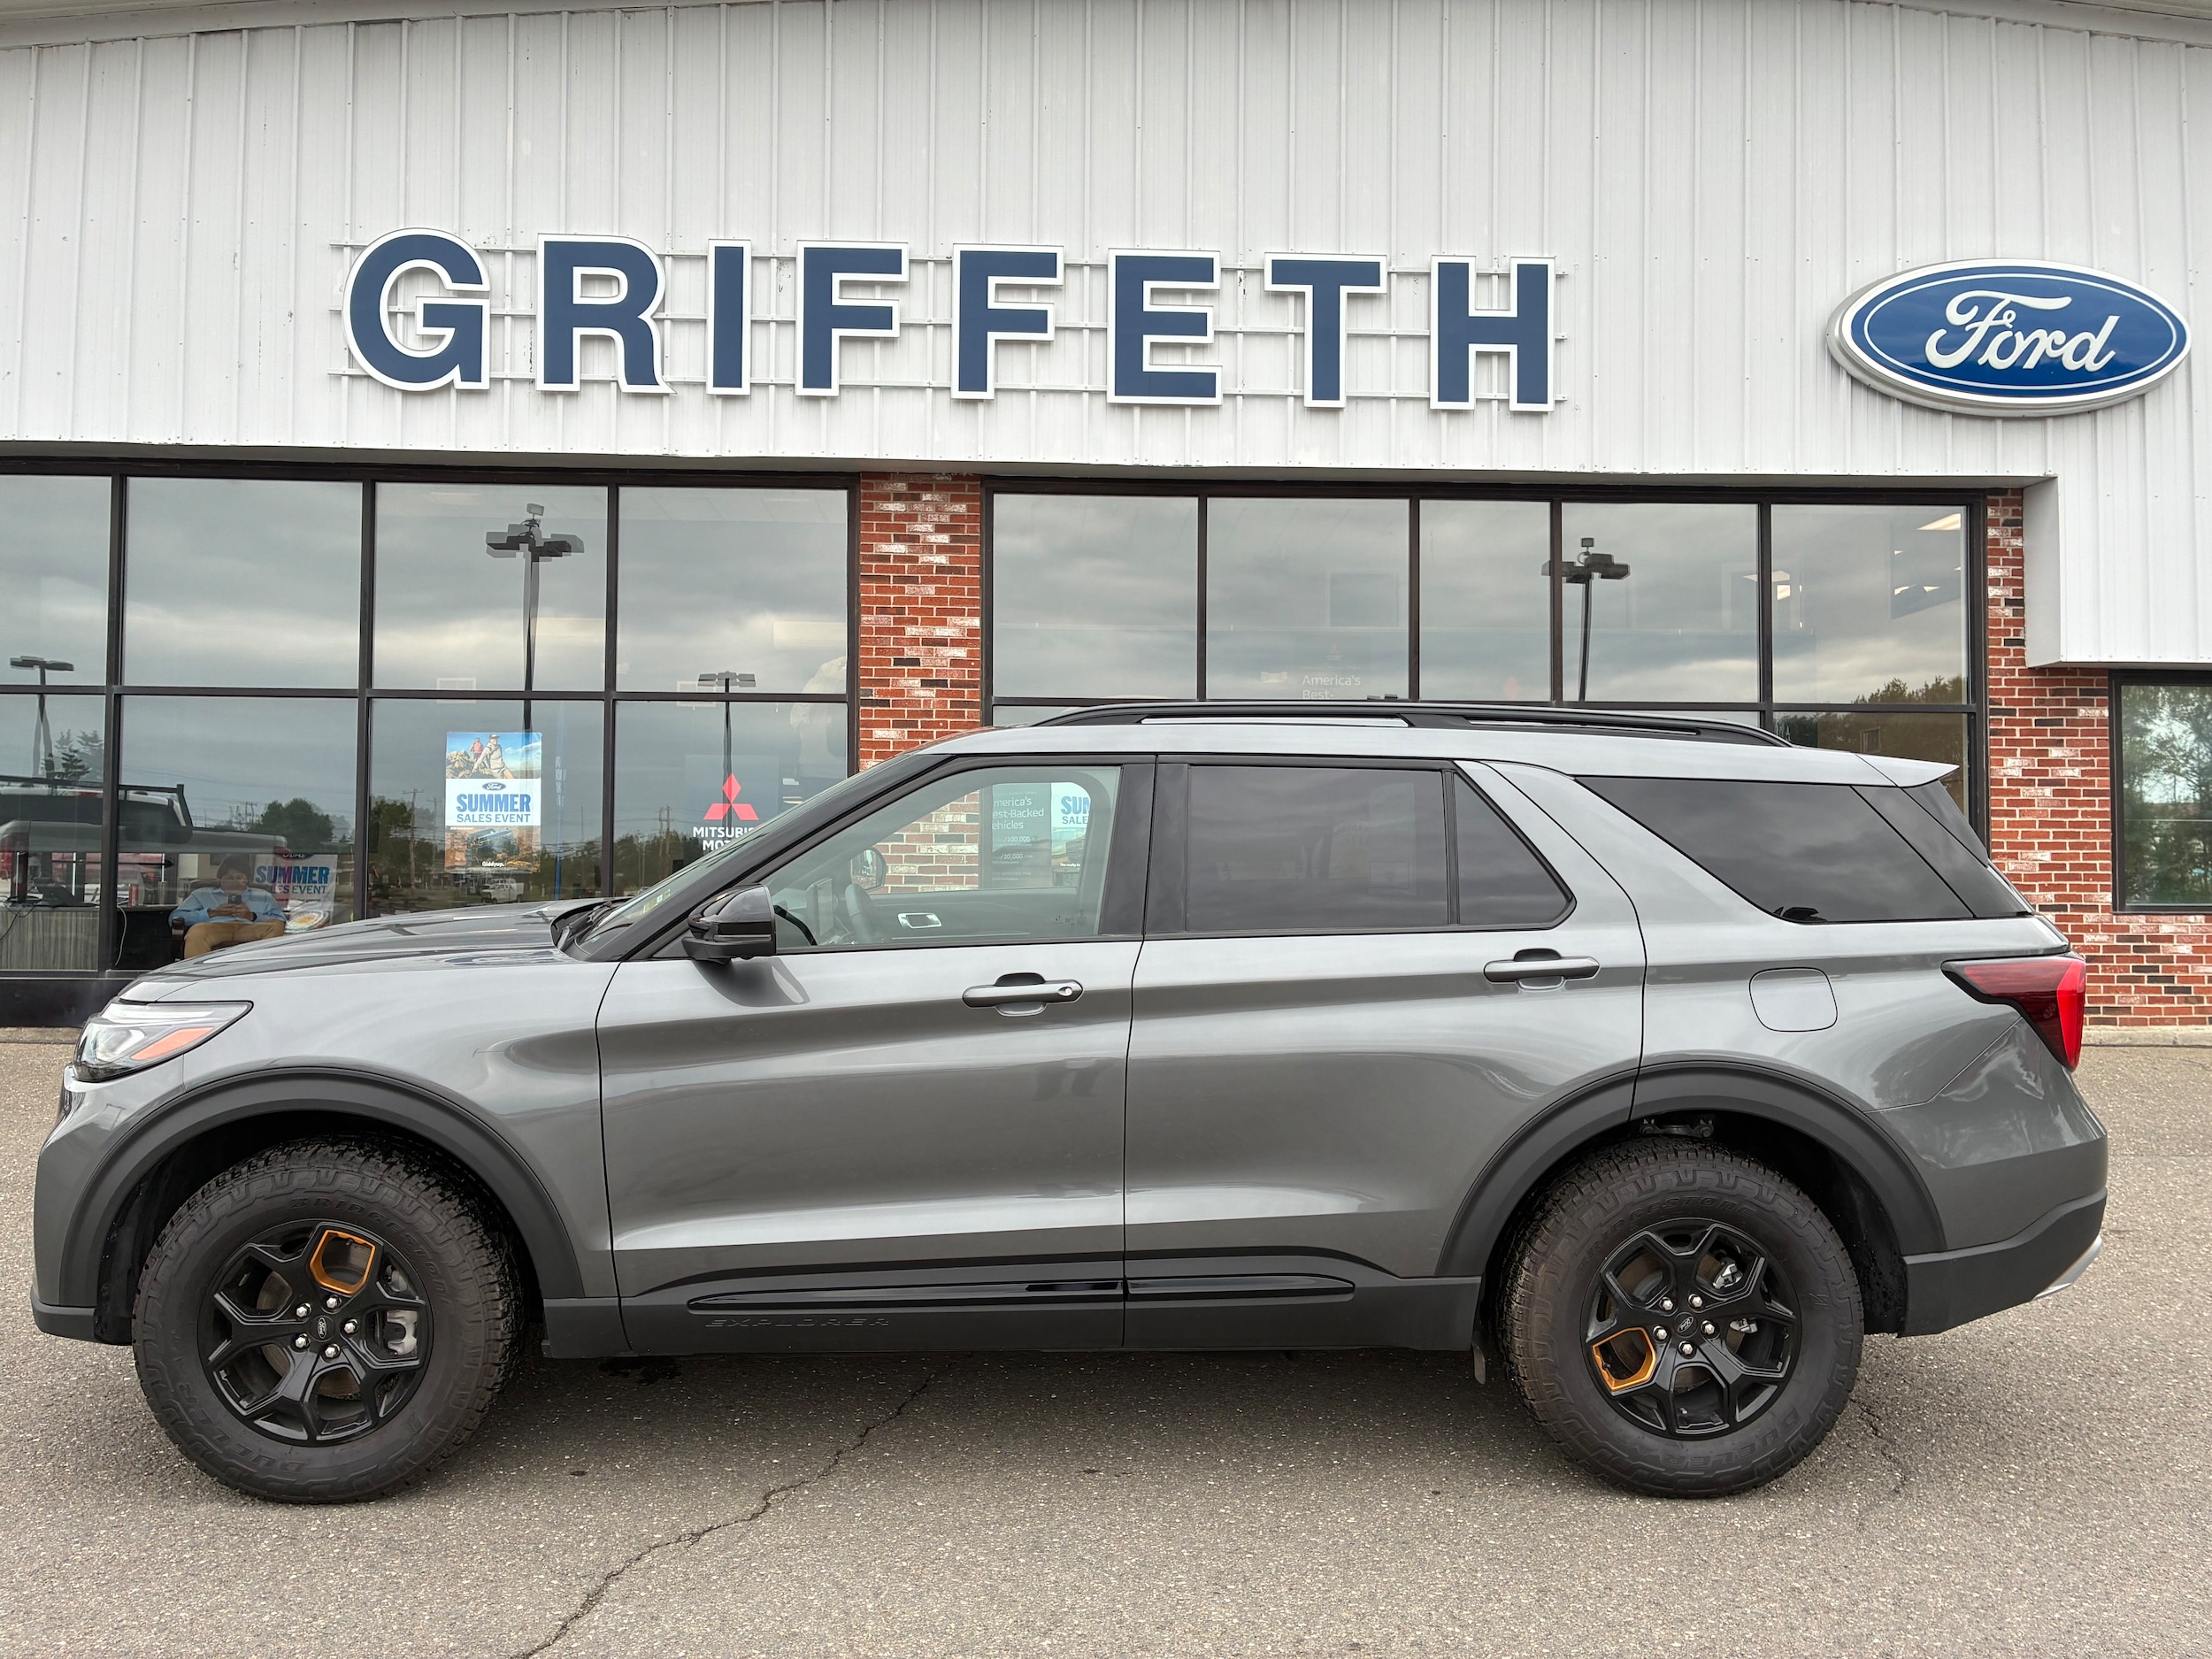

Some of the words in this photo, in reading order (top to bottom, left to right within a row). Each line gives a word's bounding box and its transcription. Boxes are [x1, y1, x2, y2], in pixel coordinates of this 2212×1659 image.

[342, 227, 1555, 413] GRIFFETH
[1924, 289, 2121, 372] Ford
[1302, 675, 1362, 686] America's
[456, 794, 531, 812] SUMMER
[457, 813, 492, 823] SALES
[495, 813, 531, 823] EVENT
[255, 865, 330, 884] SUMMER
[292, 885, 327, 895] EVENT
[704, 1317, 890, 1328] EXPLORER
